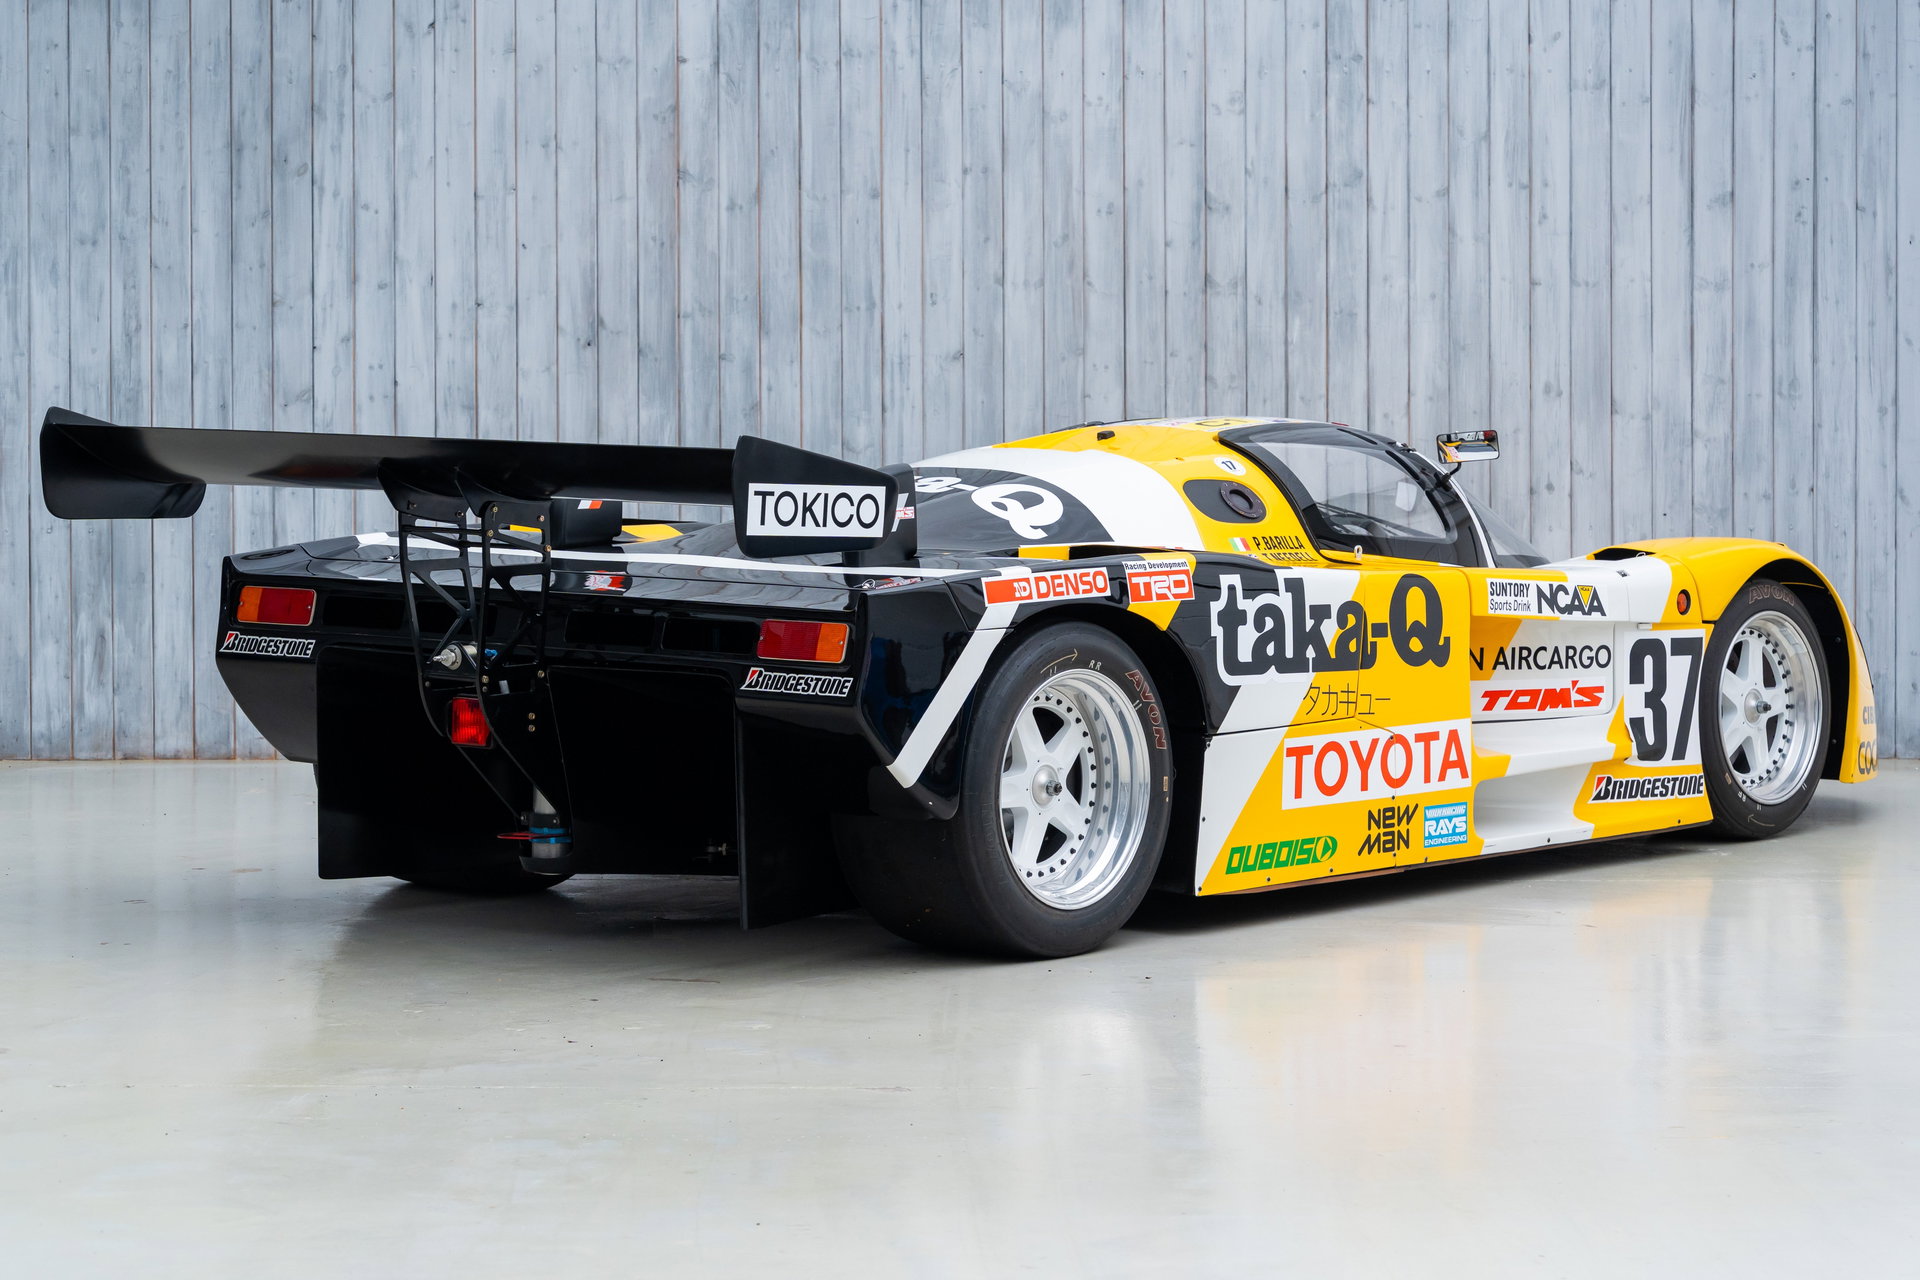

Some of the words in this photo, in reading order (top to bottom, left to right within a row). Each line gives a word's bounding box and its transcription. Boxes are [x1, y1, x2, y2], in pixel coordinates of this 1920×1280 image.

[753, 489, 881, 530] TOKICO
[1252, 535, 1306, 551] P.BARILLA
[1124, 562, 1147, 571] Racing
[1147, 560, 1189, 570] Development
[1034, 570, 1109, 600] DENSO
[1131, 573, 1190, 600] TRD
[1489, 581, 1531, 598] SUNTORY
[1749, 584, 1795, 607] AVON
[1489, 599, 1512, 612] Sports
[1513, 600, 1532, 612] Drink
[1536, 583, 1607, 617] NCAA
[1216, 573, 1451, 677] taka-Q
[220, 631, 316, 658] BRIDGESTONE
[1492, 644, 1612, 671] AIRCARGO
[741, 668, 853, 696] BRIDGESTONE
[1125, 669, 1167, 750] AVON
[1302, 682, 1391, 716] タカキュー
[1481, 680, 1604, 712] TOM'S
[1628, 636, 1704, 762] 37
[1285, 728, 1470, 800] TOYOTA
[1590, 775, 1704, 802] BRIDGESTONE
[1425, 816, 1467, 837] RAYS
[1425, 834, 1467, 847] ENGINEERING
